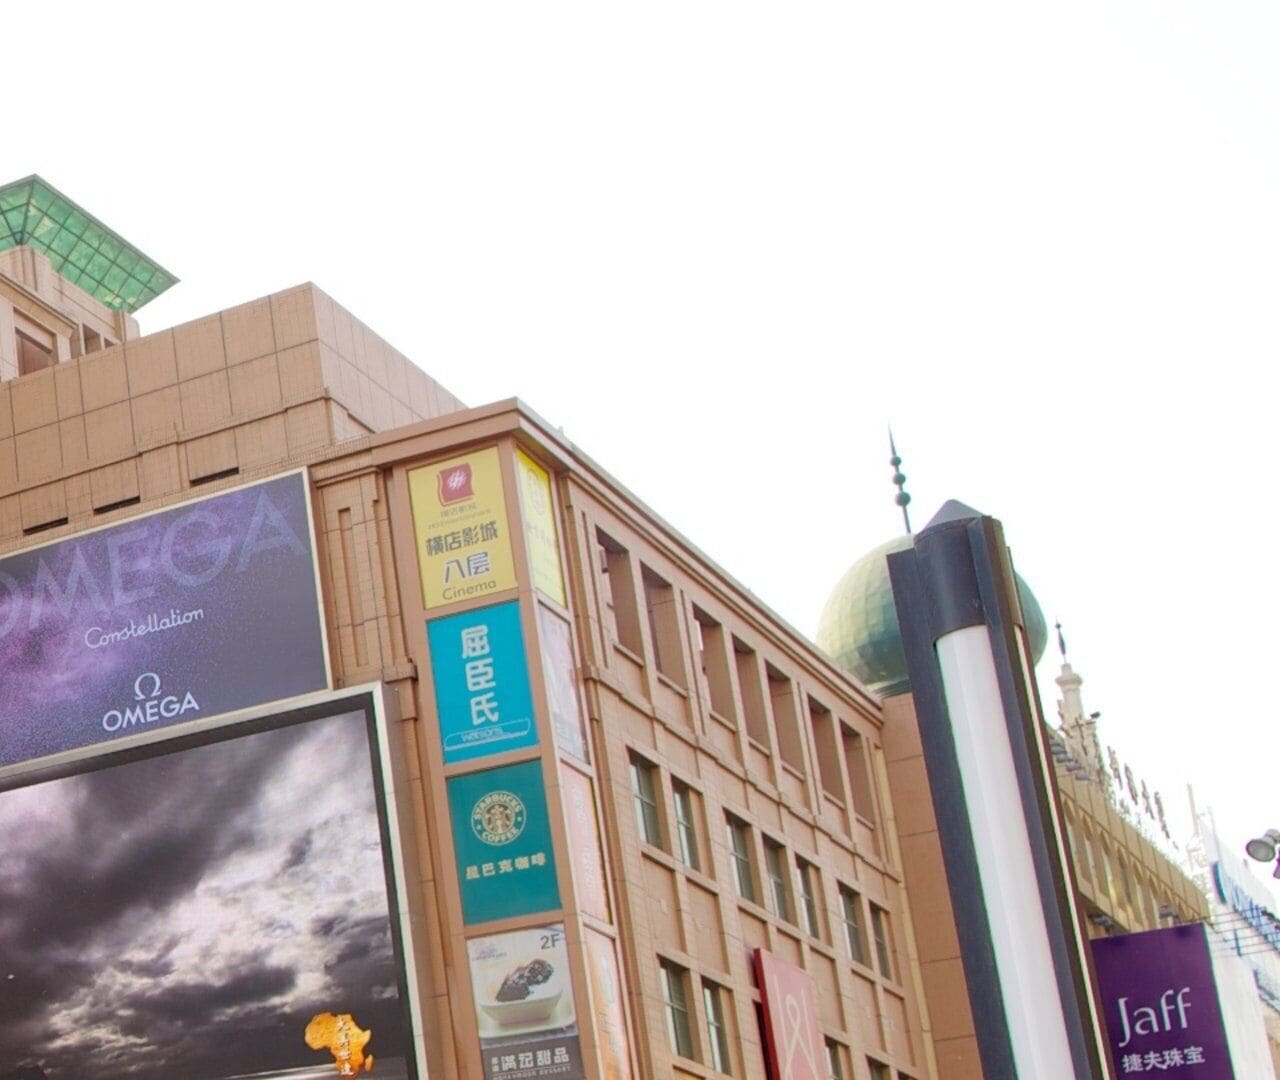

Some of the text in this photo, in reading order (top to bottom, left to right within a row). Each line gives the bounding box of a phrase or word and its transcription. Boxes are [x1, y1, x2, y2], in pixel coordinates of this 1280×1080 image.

[426, 520, 498, 556] 横店影城
[444, 551, 491, 583] 八层
[442, 580, 497, 600] Cinema
[85, 608, 205, 649] Constellation
[102, 691, 200, 731] OMEGA
[473, 790, 523, 821] STARBUCKS
[481, 827, 521, 846] COFFEE
[465, 852, 547, 880] 星巴克咖啡
[541, 933, 561, 950] 2F
[1118, 986, 1192, 1048] Jaff
[1122, 1045, 1206, 1073] 捷夫珠宝
